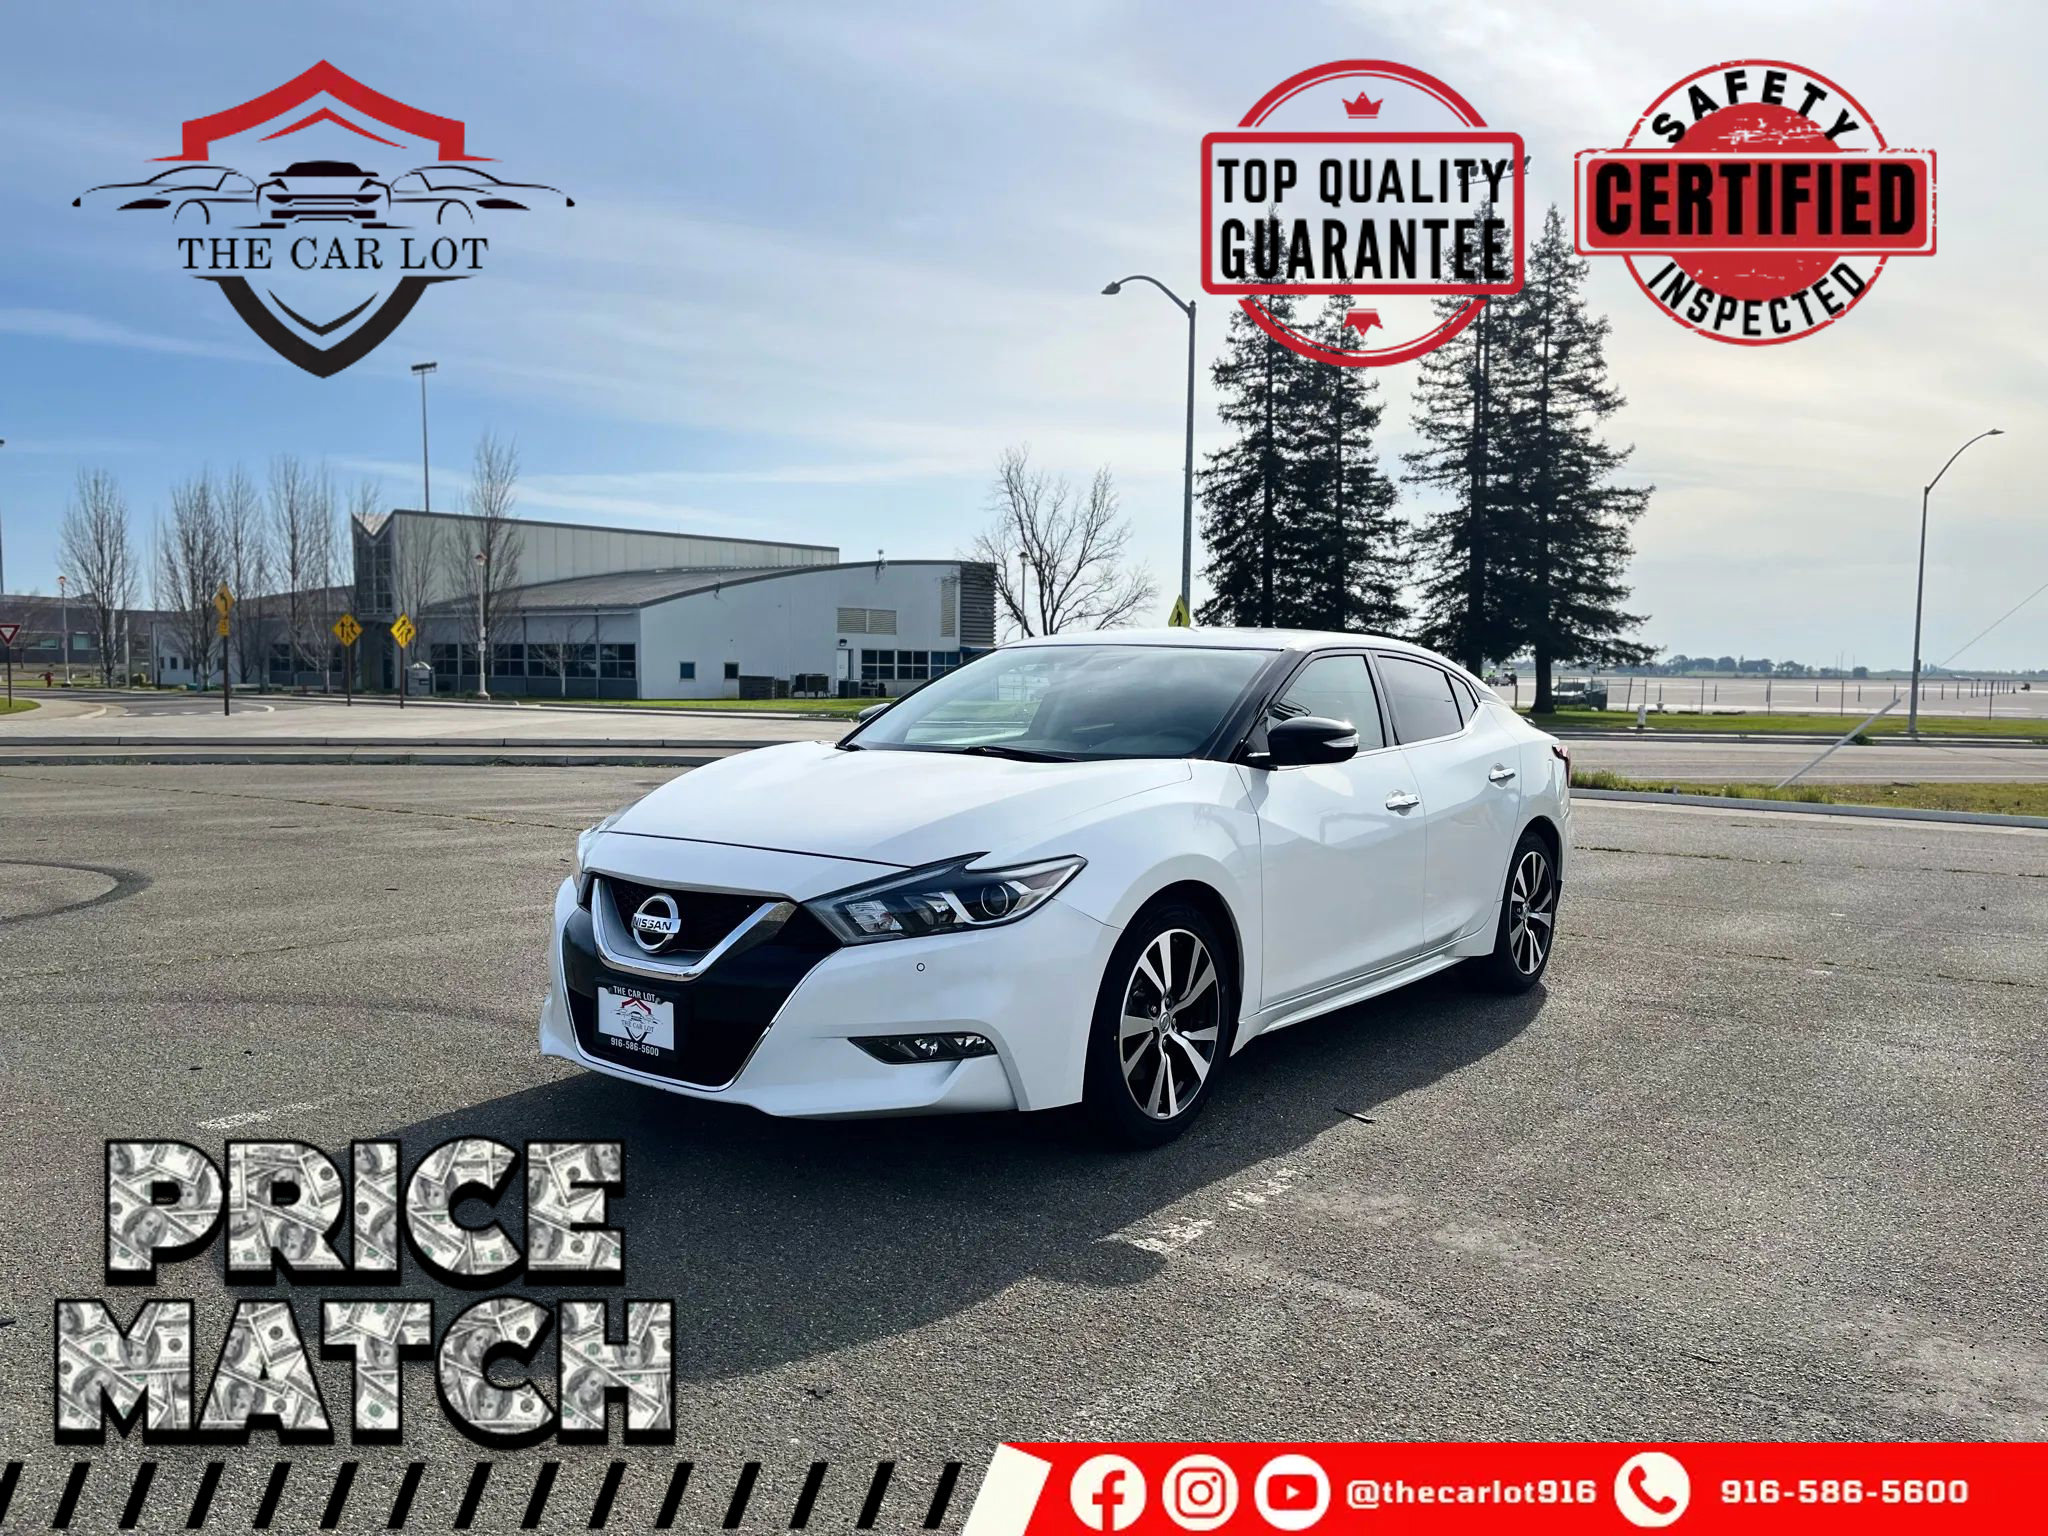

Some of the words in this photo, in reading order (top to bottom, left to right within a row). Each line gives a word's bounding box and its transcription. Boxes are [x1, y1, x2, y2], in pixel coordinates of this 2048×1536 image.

[632, 916, 673, 931] NISSAN
[613, 985, 627, 996] THE
[627, 988, 642, 999] CAR
[643, 992, 656, 1002] LOT
[610, 1037, 660, 1057] 916-586-5600
